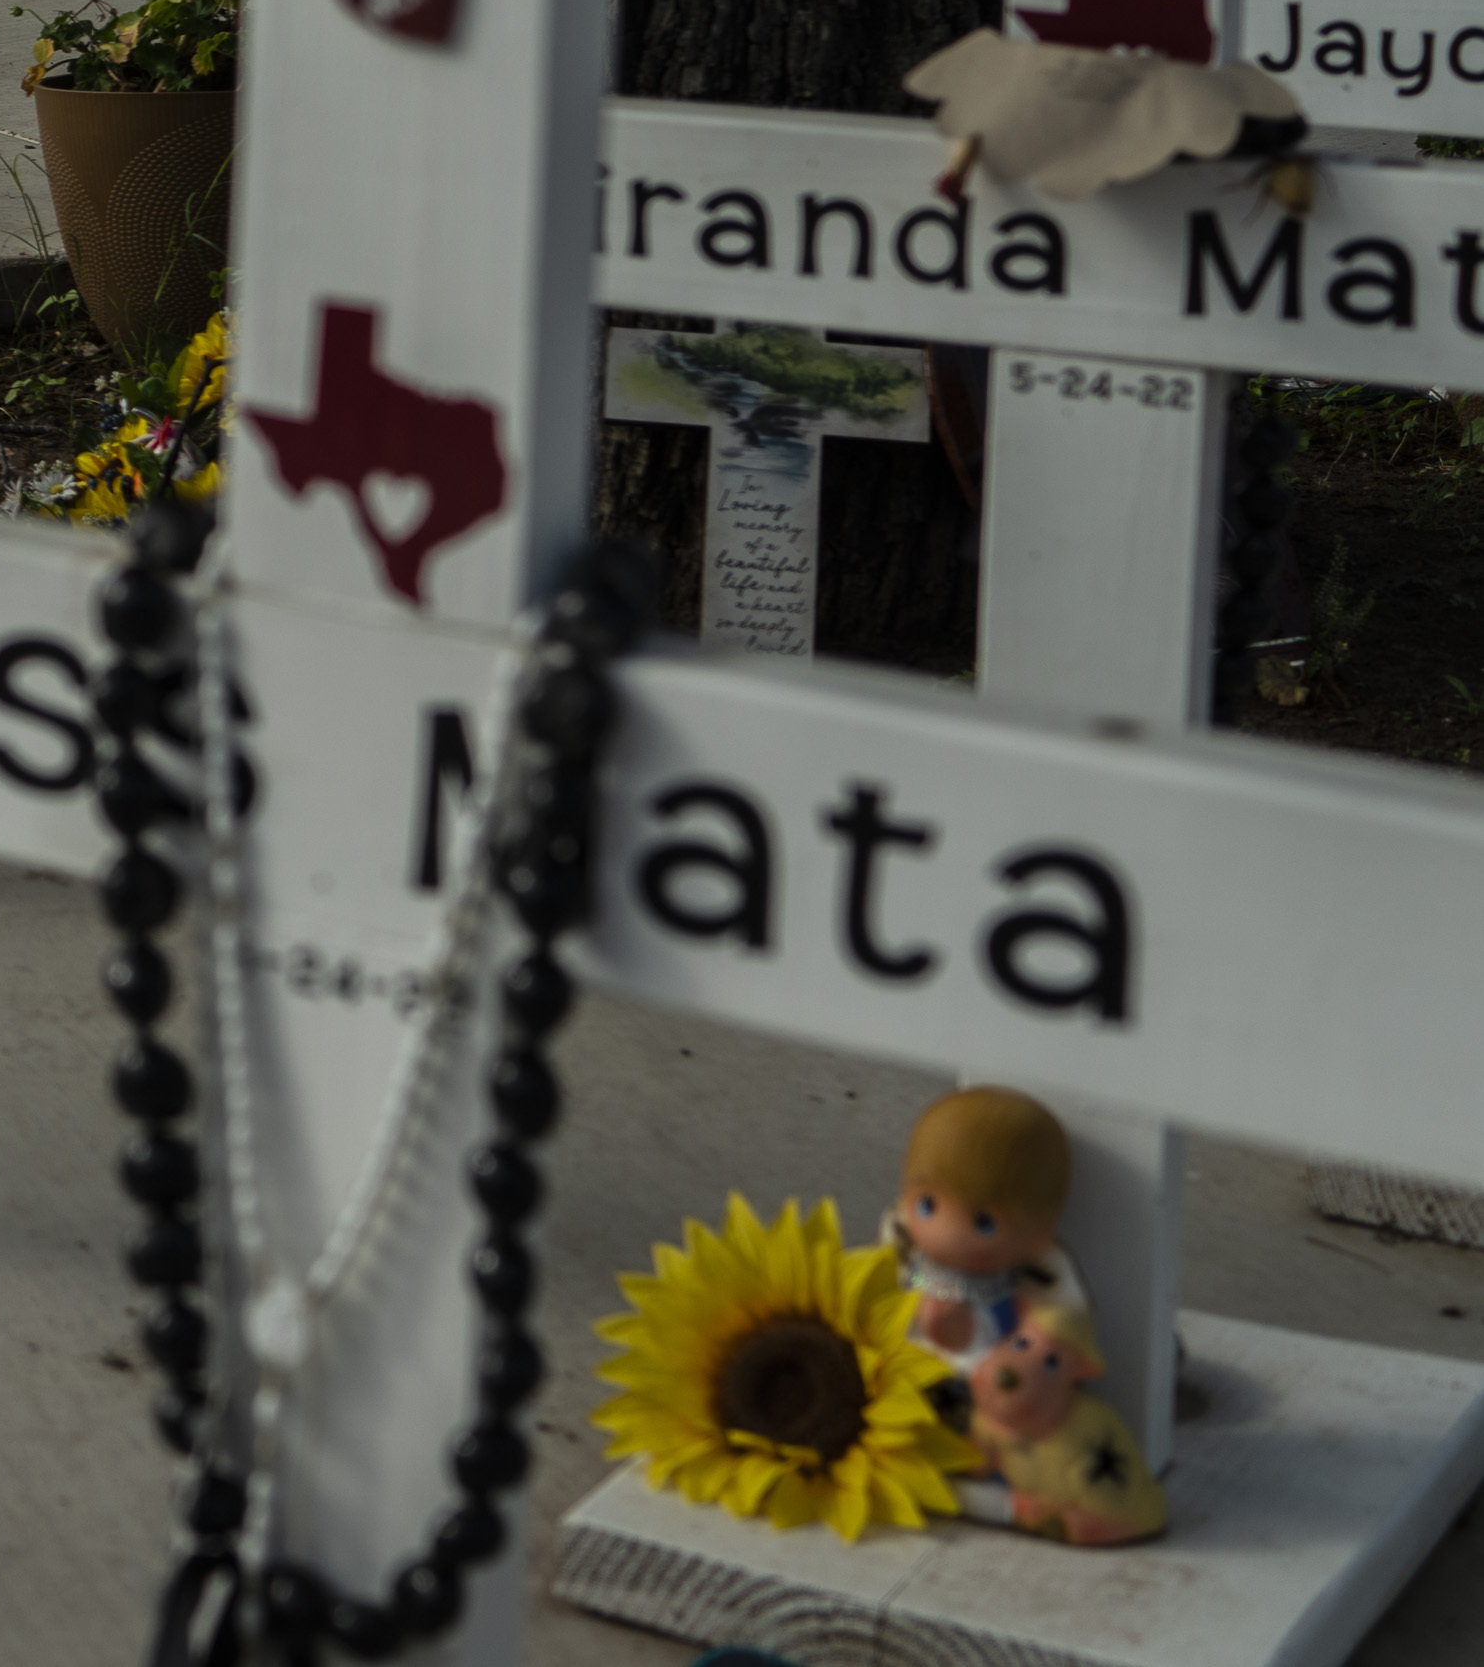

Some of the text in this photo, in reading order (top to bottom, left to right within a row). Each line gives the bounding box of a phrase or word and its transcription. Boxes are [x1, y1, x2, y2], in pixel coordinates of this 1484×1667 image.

[1185, 210, 1484, 335] Mat
[1009, 361, 1197, 409] 5-24-22
[717, 488, 792, 521] Loving
[733, 519, 805, 544] memory
[714, 549, 811, 578] beautiful
[720, 572, 761, 597] life
